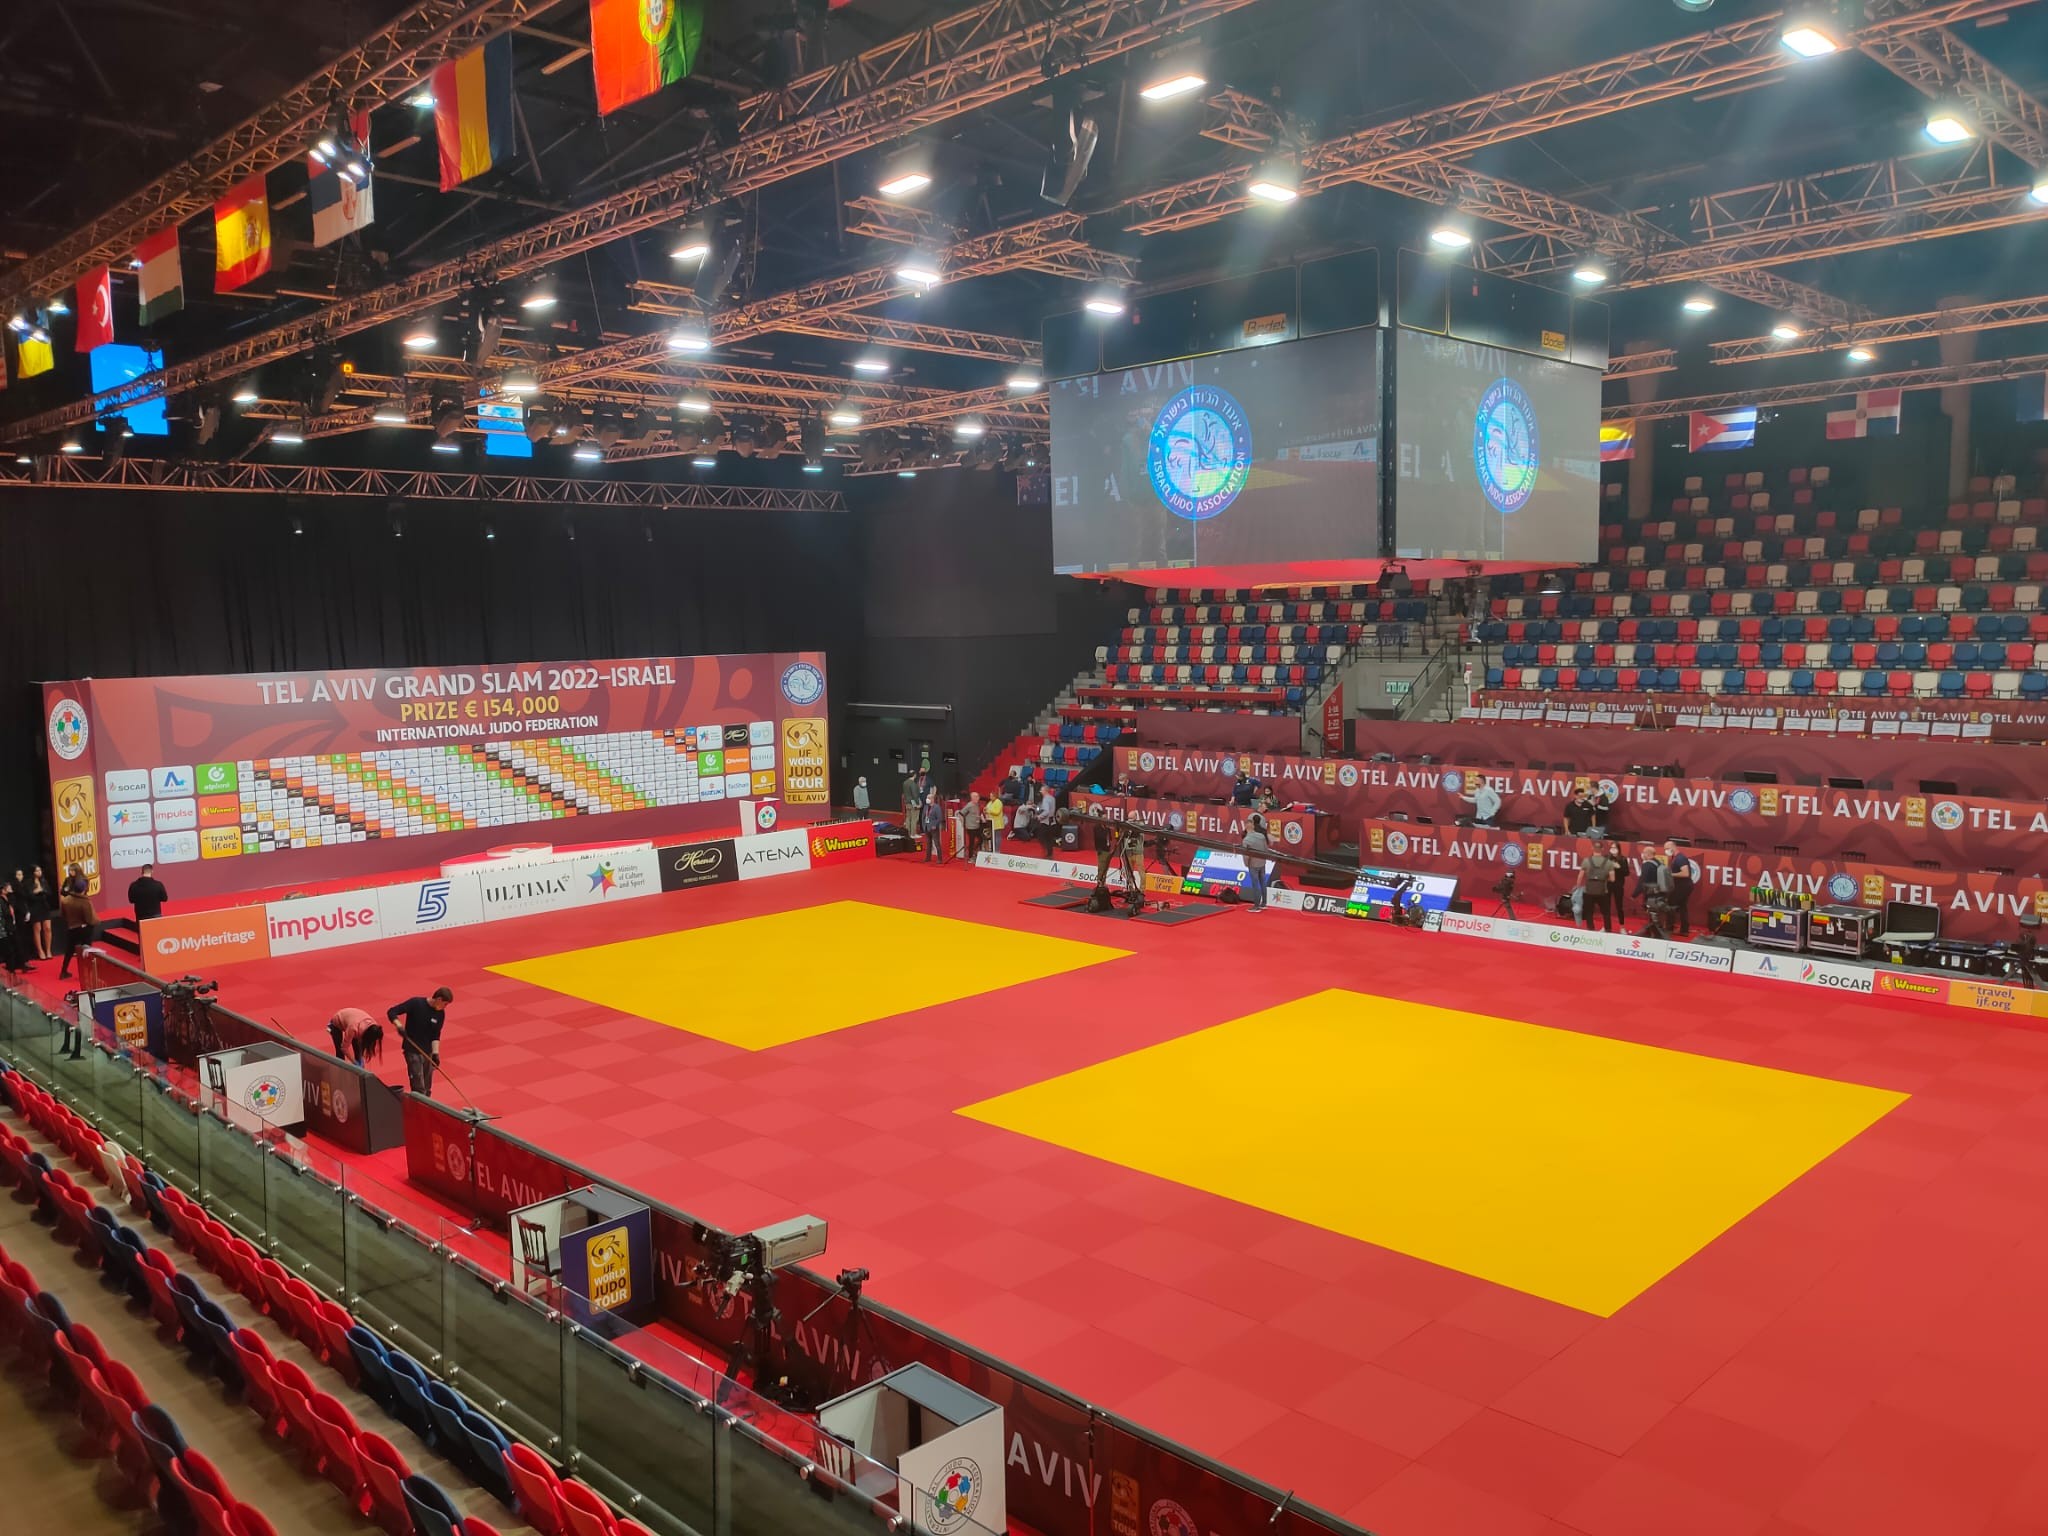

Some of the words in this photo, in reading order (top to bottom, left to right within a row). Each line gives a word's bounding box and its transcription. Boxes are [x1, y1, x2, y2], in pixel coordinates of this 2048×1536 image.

[1153, 459, 1172, 497] ISRAEL
[1169, 492, 1194, 512] JUDO
[1196, 451, 1246, 512] ASSOCIATION
[1477, 446, 1490, 485] ISRAEL
[1487, 482, 1504, 505] JUDO
[1504, 452, 1536, 506] ASSOCIATION
[257, 681, 304, 705] TEL
[312, 678, 377, 702] AVIV
[385, 673, 475, 699] GRAND
[482, 671, 543, 694] SLAM
[401, 700, 459, 722] PRIZE
[464, 700, 478, 718] €
[484, 695, 560, 718] 154,000
[377, 723, 486, 742] INTERNATIONAL
[488, 720, 523, 735] JUDO
[525, 715, 599, 732] FEDERATION
[1995, 714, 2013, 723] TEL
[2017, 715, 2047, 724] AVIV
[788, 757, 824, 766] WORLD
[1156, 756, 1178, 772] TEL
[1183, 757, 1220, 774] AVIV
[788, 766, 823, 778] JUDO
[1252, 762, 1278, 779] TEL
[1282, 763, 1323, 781] AVIV
[1361, 769, 1389, 787] TEL
[1395, 770, 1440, 789] AVIV
[118, 783, 146, 792] SOCAR
[788, 778, 824, 789] TOUR
[1485, 776, 1515, 795] TEL
[1521, 778, 1572, 797] AVIV
[787, 794, 803, 802] TEL
[807, 793, 827, 801] AVIV
[1622, 785, 1659, 804] TEL
[1667, 787, 1726, 809] AVIV
[155, 809, 194, 821] impulse
[1782, 795, 1823, 816] TEL
[1833, 798, 1901, 821] AVIV
[1199, 816, 1223, 834] TEL
[1969, 807, 2017, 831] TEL
[62, 831, 94, 848] WORLD
[824, 836, 869, 851] Winner
[1410, 836, 1441, 856] TEL
[1448, 841, 1498, 861] AVIV
[63, 843, 94, 865] JUDO
[112, 847, 152, 858] ATENA
[742, 846, 804, 865] ATENA
[1547, 849, 1582, 871] TEL
[625, 872, 643, 880] Culture
[1237, 871, 1246, 881] 0
[1706, 865, 1747, 887] TEL
[1757, 870, 1824, 895] AVIV
[487, 879, 566, 903] ULTIMA
[1416, 882, 1425, 892] 0
[415, 880, 451, 924] 5
[1890, 883, 1939, 906] TEL
[1949, 889, 2030, 917] AVIV
[269, 906, 375, 941] impulse
[1443, 915, 1491, 932] impulse
[181, 929, 256, 951] MyHeritage
[1562, 934, 1604, 947] otpbank
[1616, 947, 1655, 959] SUZUKI
[1667, 946, 1730, 966] TaiShan
[1818, 973, 1873, 992] SOCAR
[1893, 978, 1940, 995] Winner
[1977, 986, 2015, 1000] travel.
[594, 1268, 626, 1286] WORLD
[603, 1263, 616, 1273] IJF
[594, 1277, 627, 1299] JUDO
[594, 1288, 627, 1311] TOUR
[1007, 1431, 1103, 1509] AVIV
